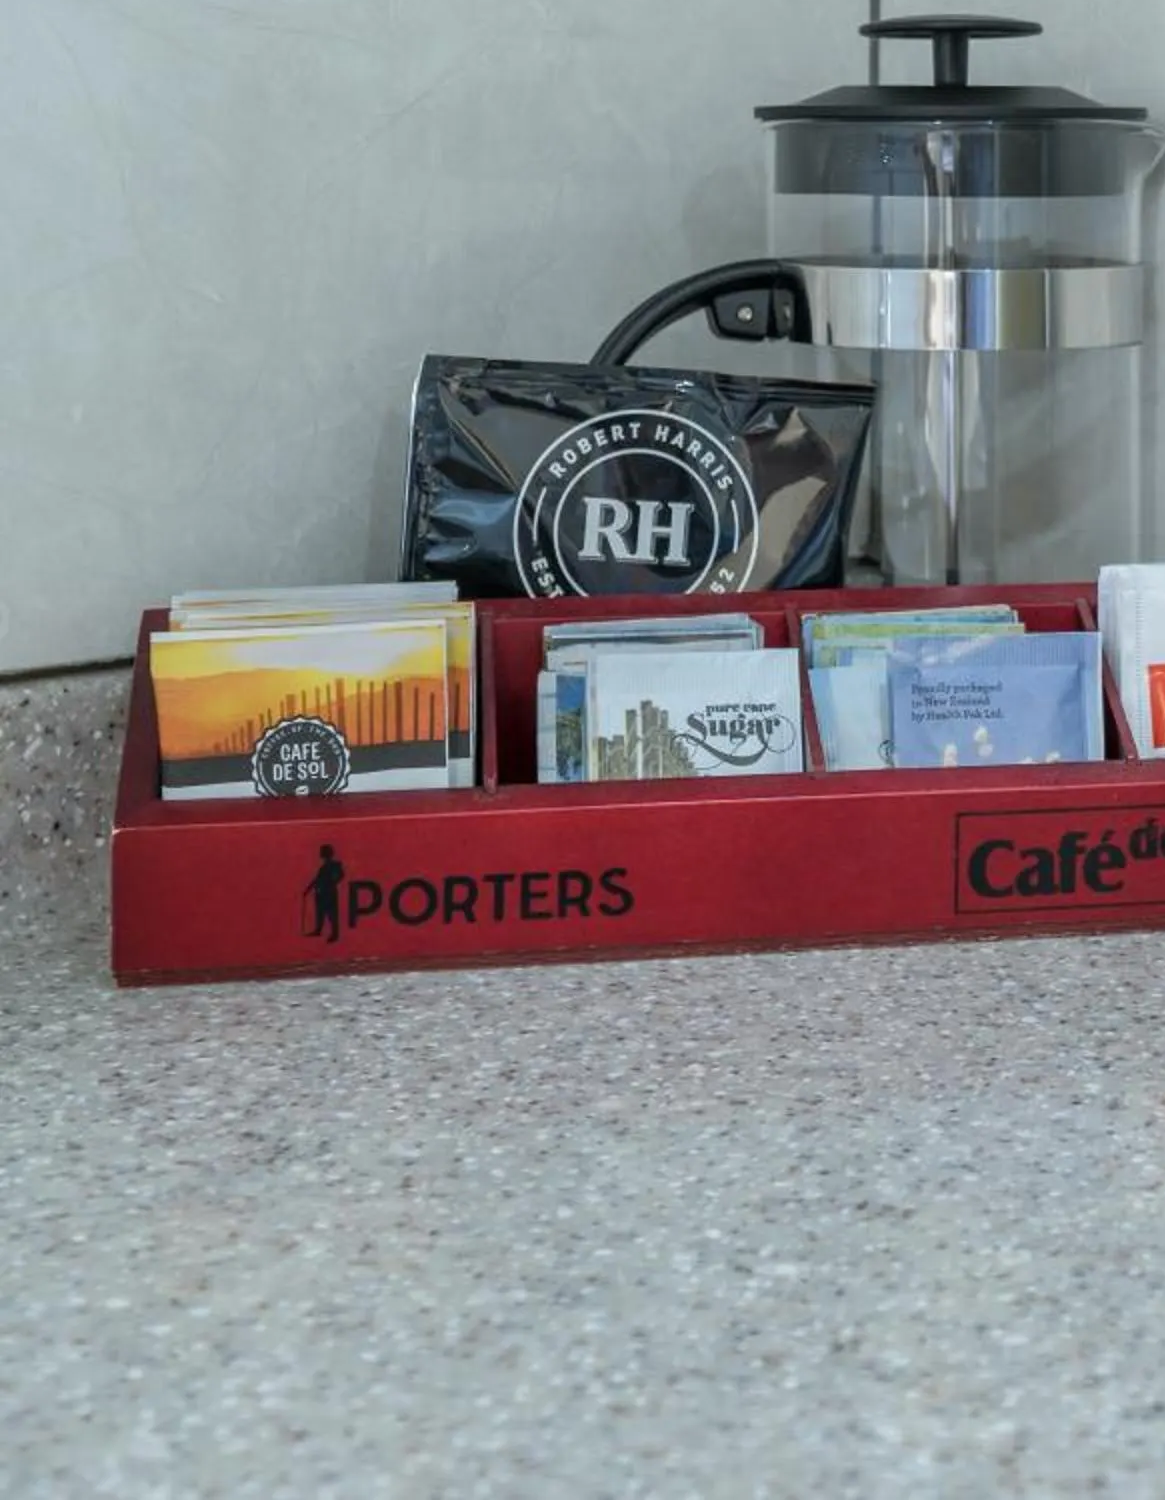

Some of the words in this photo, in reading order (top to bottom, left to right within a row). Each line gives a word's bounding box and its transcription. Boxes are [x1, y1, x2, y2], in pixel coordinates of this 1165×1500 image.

[549, 422, 641, 479] ROBERT
[654, 424, 734, 490] HARRIS
[577, 497, 695, 567] RH
[680, 711, 791, 762] Sugar
[705, 703, 740, 717] pure
[273, 763, 294, 781] DE
[280, 741, 321, 761] CAFE
[967, 830, 1127, 898] Café
[347, 867, 635, 929] PORTERS
